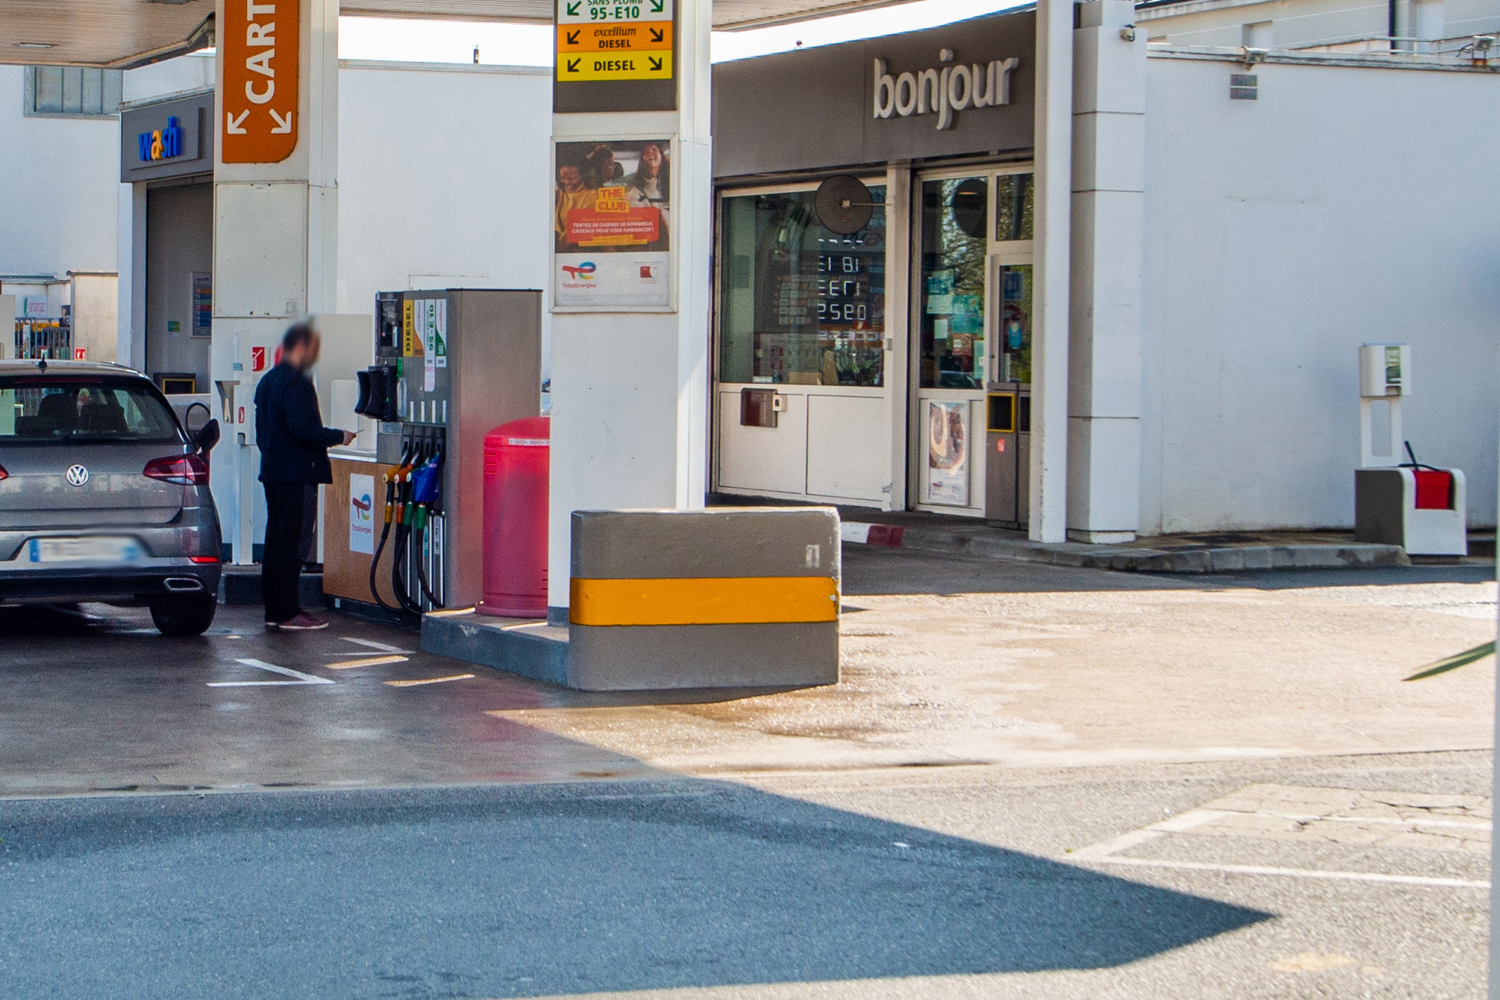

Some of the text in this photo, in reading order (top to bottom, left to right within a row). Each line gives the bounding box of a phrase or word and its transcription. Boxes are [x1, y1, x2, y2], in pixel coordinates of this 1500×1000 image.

[590, 5, 640, 20] 95-E10
[594, 26, 636, 37] excellium
[598, 39, 631, 49] DIESEL
[594, 60, 636, 71] DIESEL
[873, 48, 1019, 130] bonjour
[138, 115, 182, 162] wash
[601, 188, 623, 199] THE
[597, 201, 627, 211] CLUB
